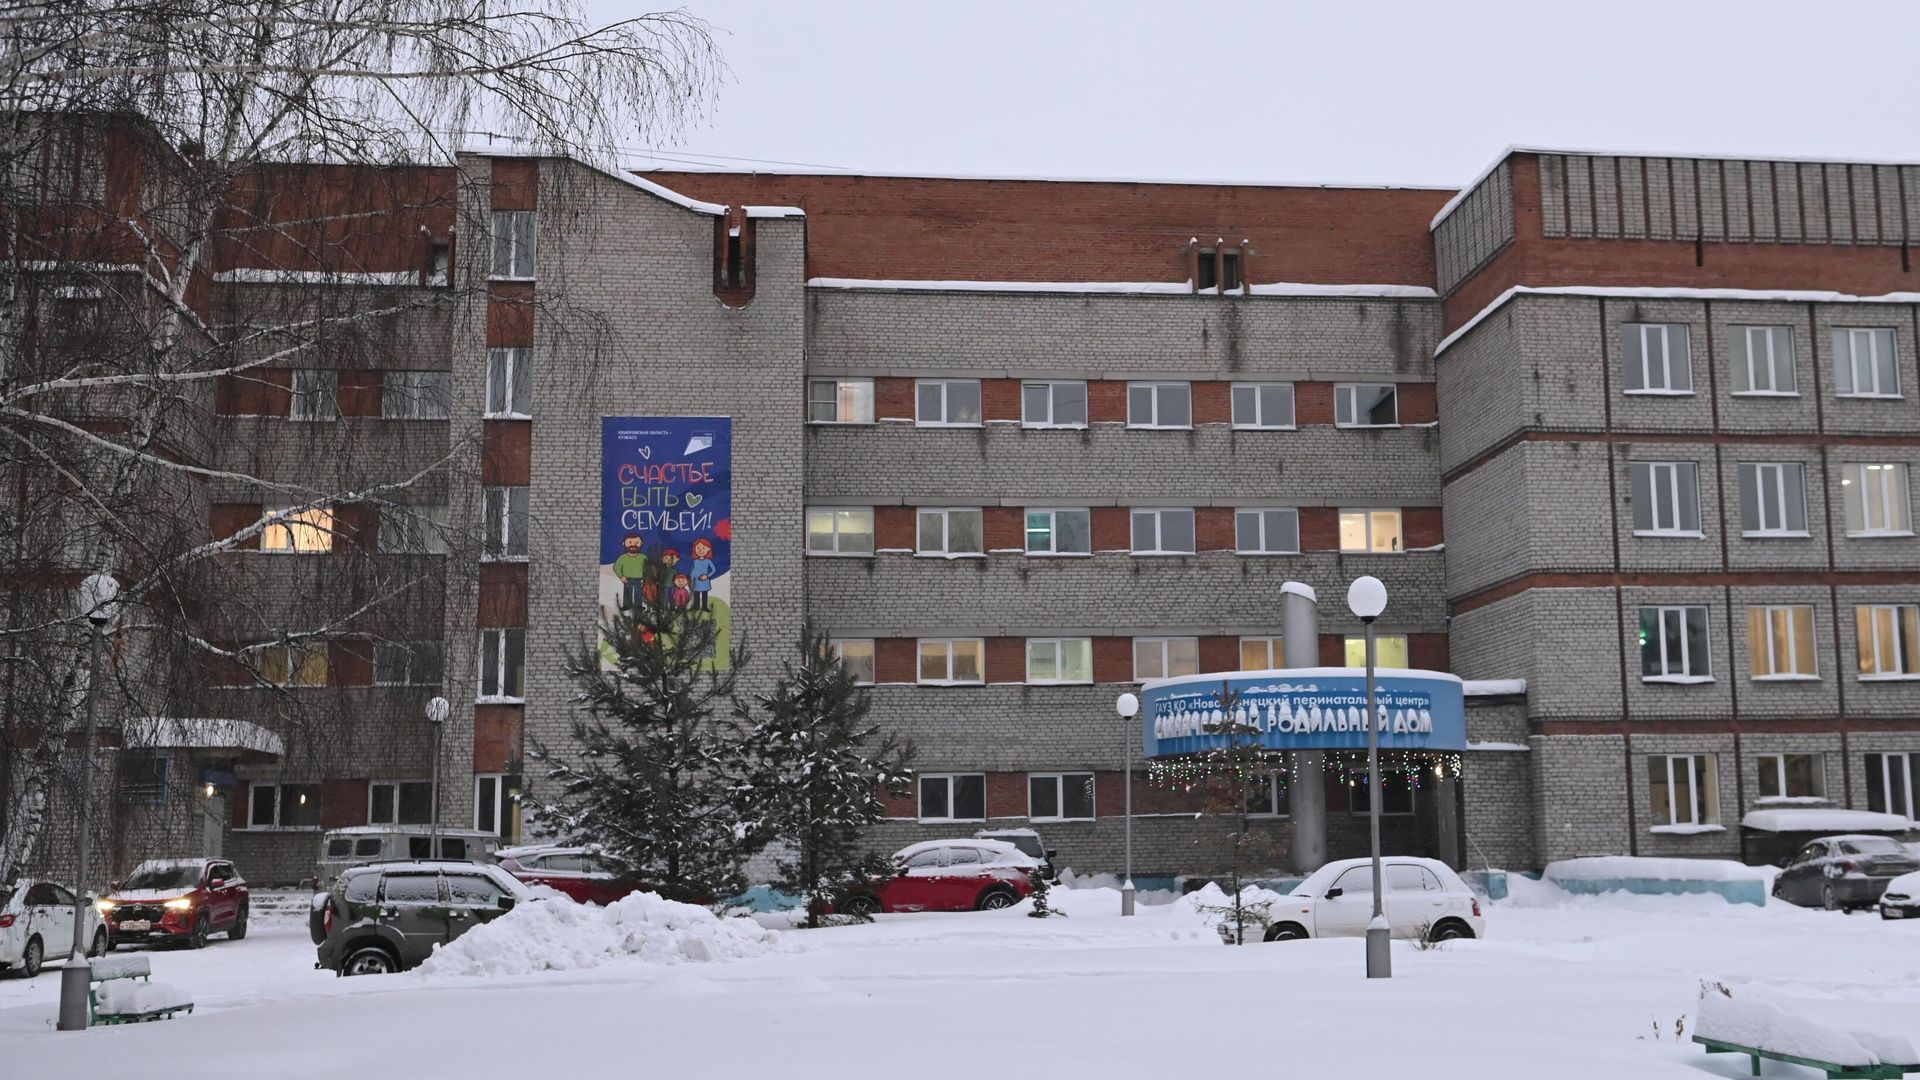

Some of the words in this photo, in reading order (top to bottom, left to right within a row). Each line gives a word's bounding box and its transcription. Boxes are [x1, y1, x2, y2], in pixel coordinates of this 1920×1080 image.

[618, 462, 714, 485] СЧАСТЬЕ
[621, 486, 680, 508] БЫТЬ
[1155, 701, 1172, 713] ГАУЗ
[1173, 700, 1186, 712] КО
[1189, 695, 1290, 708] «Новонецкий
[1293, 695, 1393, 708] перинатальый
[1395, 696, 1429, 708] центр»
[1393, 708, 1433, 734] ДОМ
